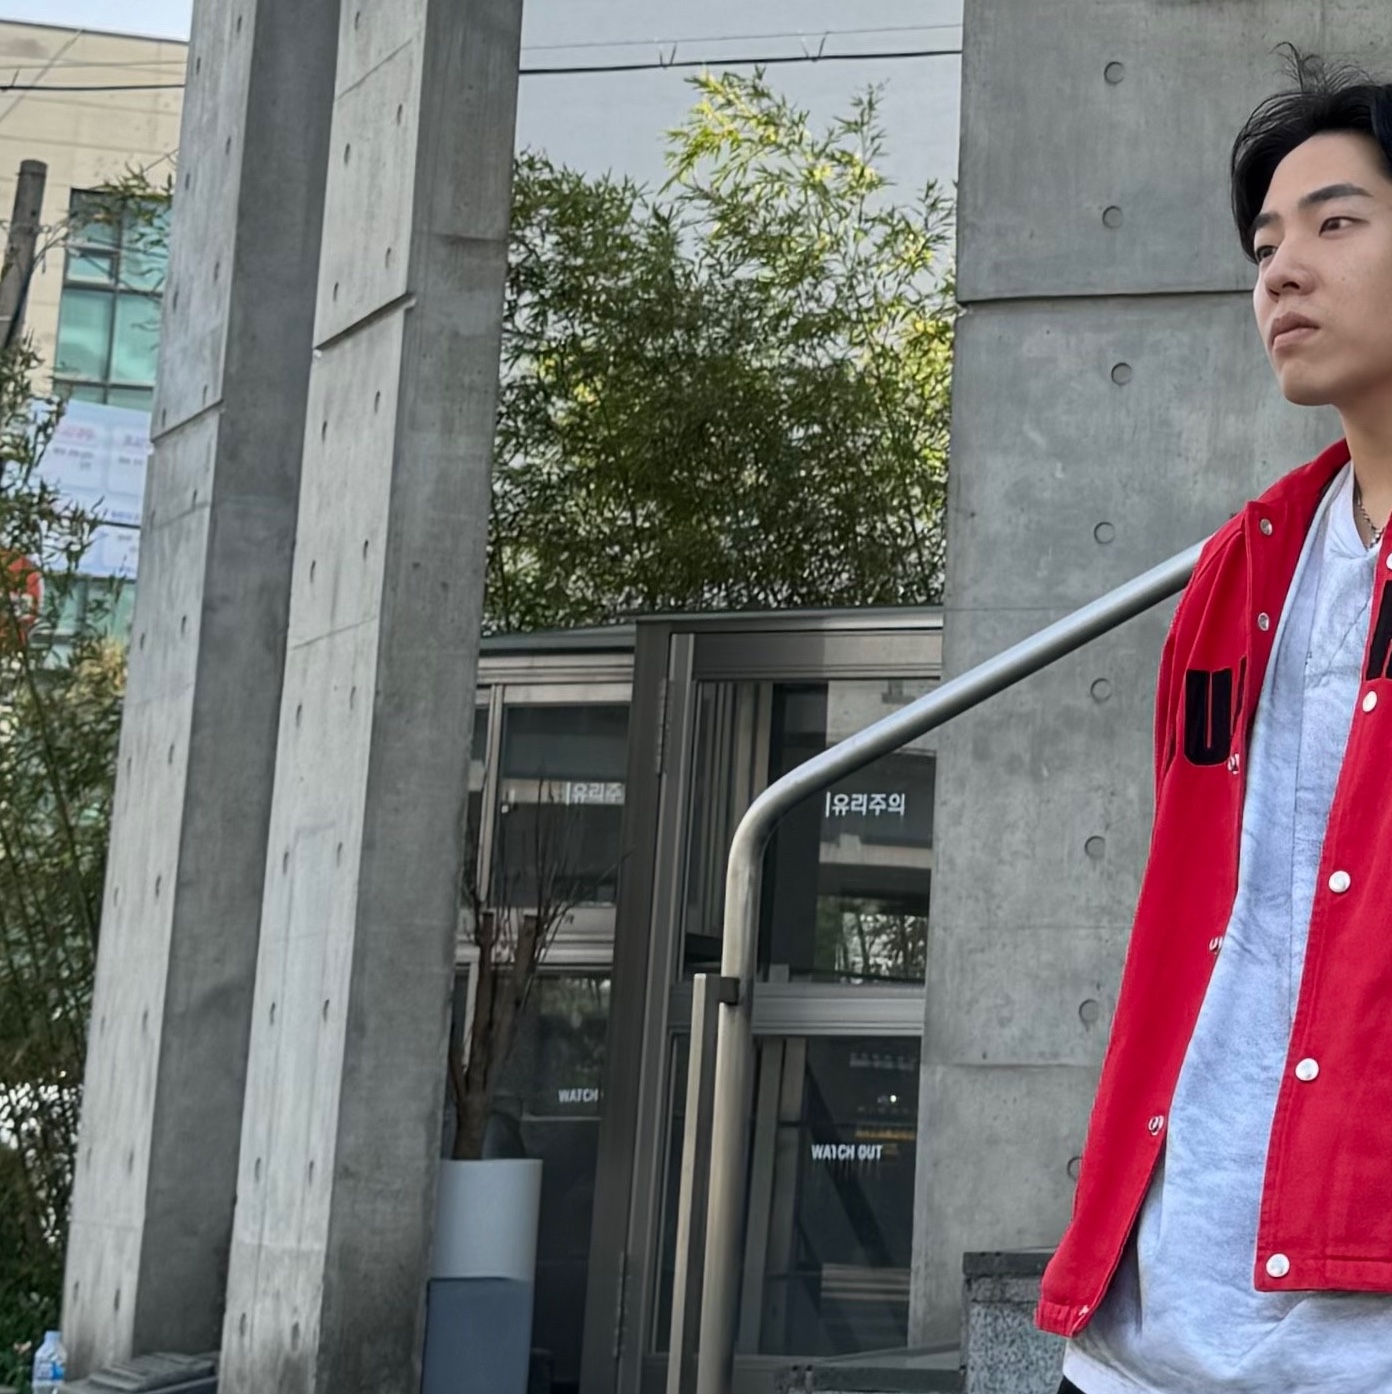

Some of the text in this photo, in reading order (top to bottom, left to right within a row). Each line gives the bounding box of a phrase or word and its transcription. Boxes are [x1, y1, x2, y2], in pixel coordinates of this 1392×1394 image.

[1184, 655, 1247, 767] U
[572, 782, 625, 804] 유리주
[832, 793, 906, 817] 유리주의
[558, 1087, 599, 1103] WATCH
[811, 1144, 883, 1161] WATCH OUT
